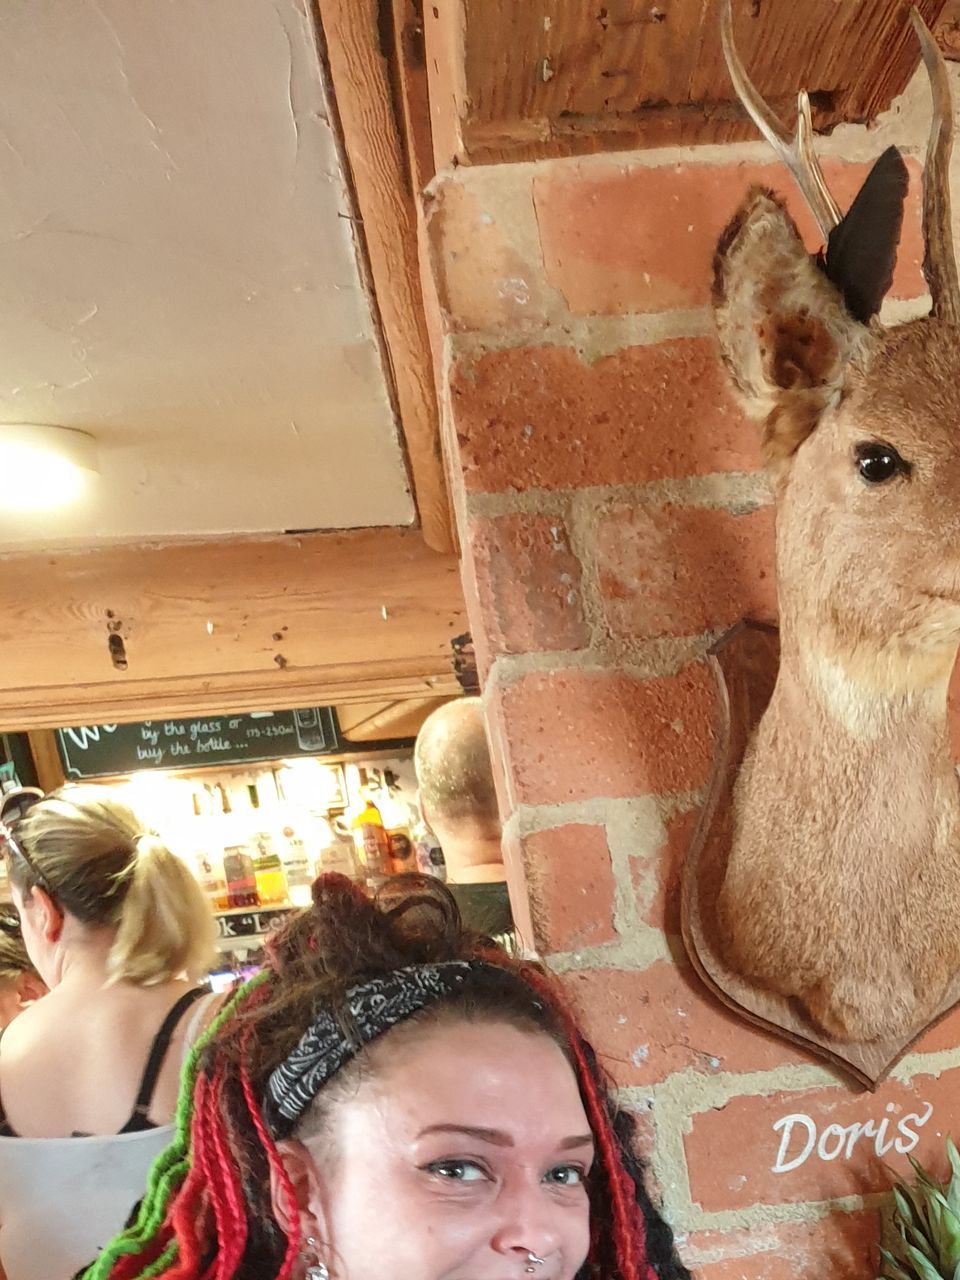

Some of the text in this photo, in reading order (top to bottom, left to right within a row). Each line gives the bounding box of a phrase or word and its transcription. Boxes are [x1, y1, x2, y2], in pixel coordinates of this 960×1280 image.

[141, 718, 243, 745] by the glass or
[137, 745, 163, 764] buy
[171, 742, 191, 756] the
[197, 736, 232, 753] bottle
[771, 1101, 934, 1174] Doris
